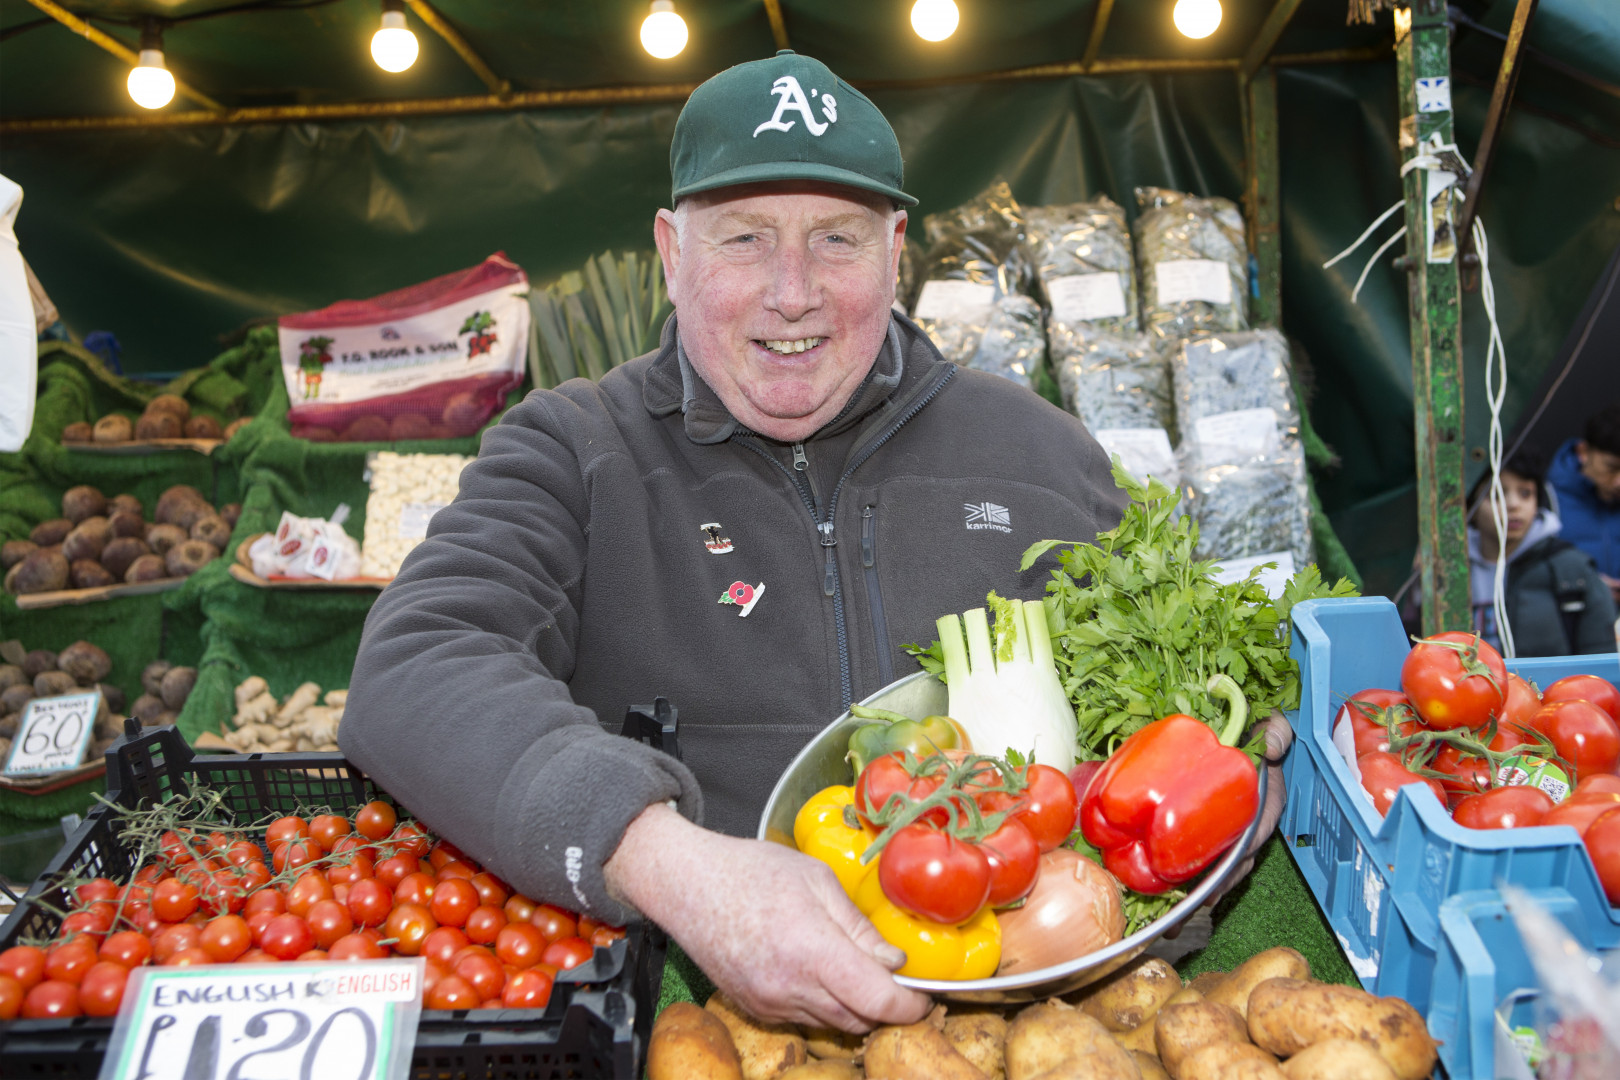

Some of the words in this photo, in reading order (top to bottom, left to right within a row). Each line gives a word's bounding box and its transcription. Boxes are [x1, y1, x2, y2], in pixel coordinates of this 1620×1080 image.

[753, 75, 838, 138] A's
[965, 521, 1013, 534] karrimor
[153, 981, 295, 1007] ENGLISH
[337, 972, 412, 995] ENGLISH
